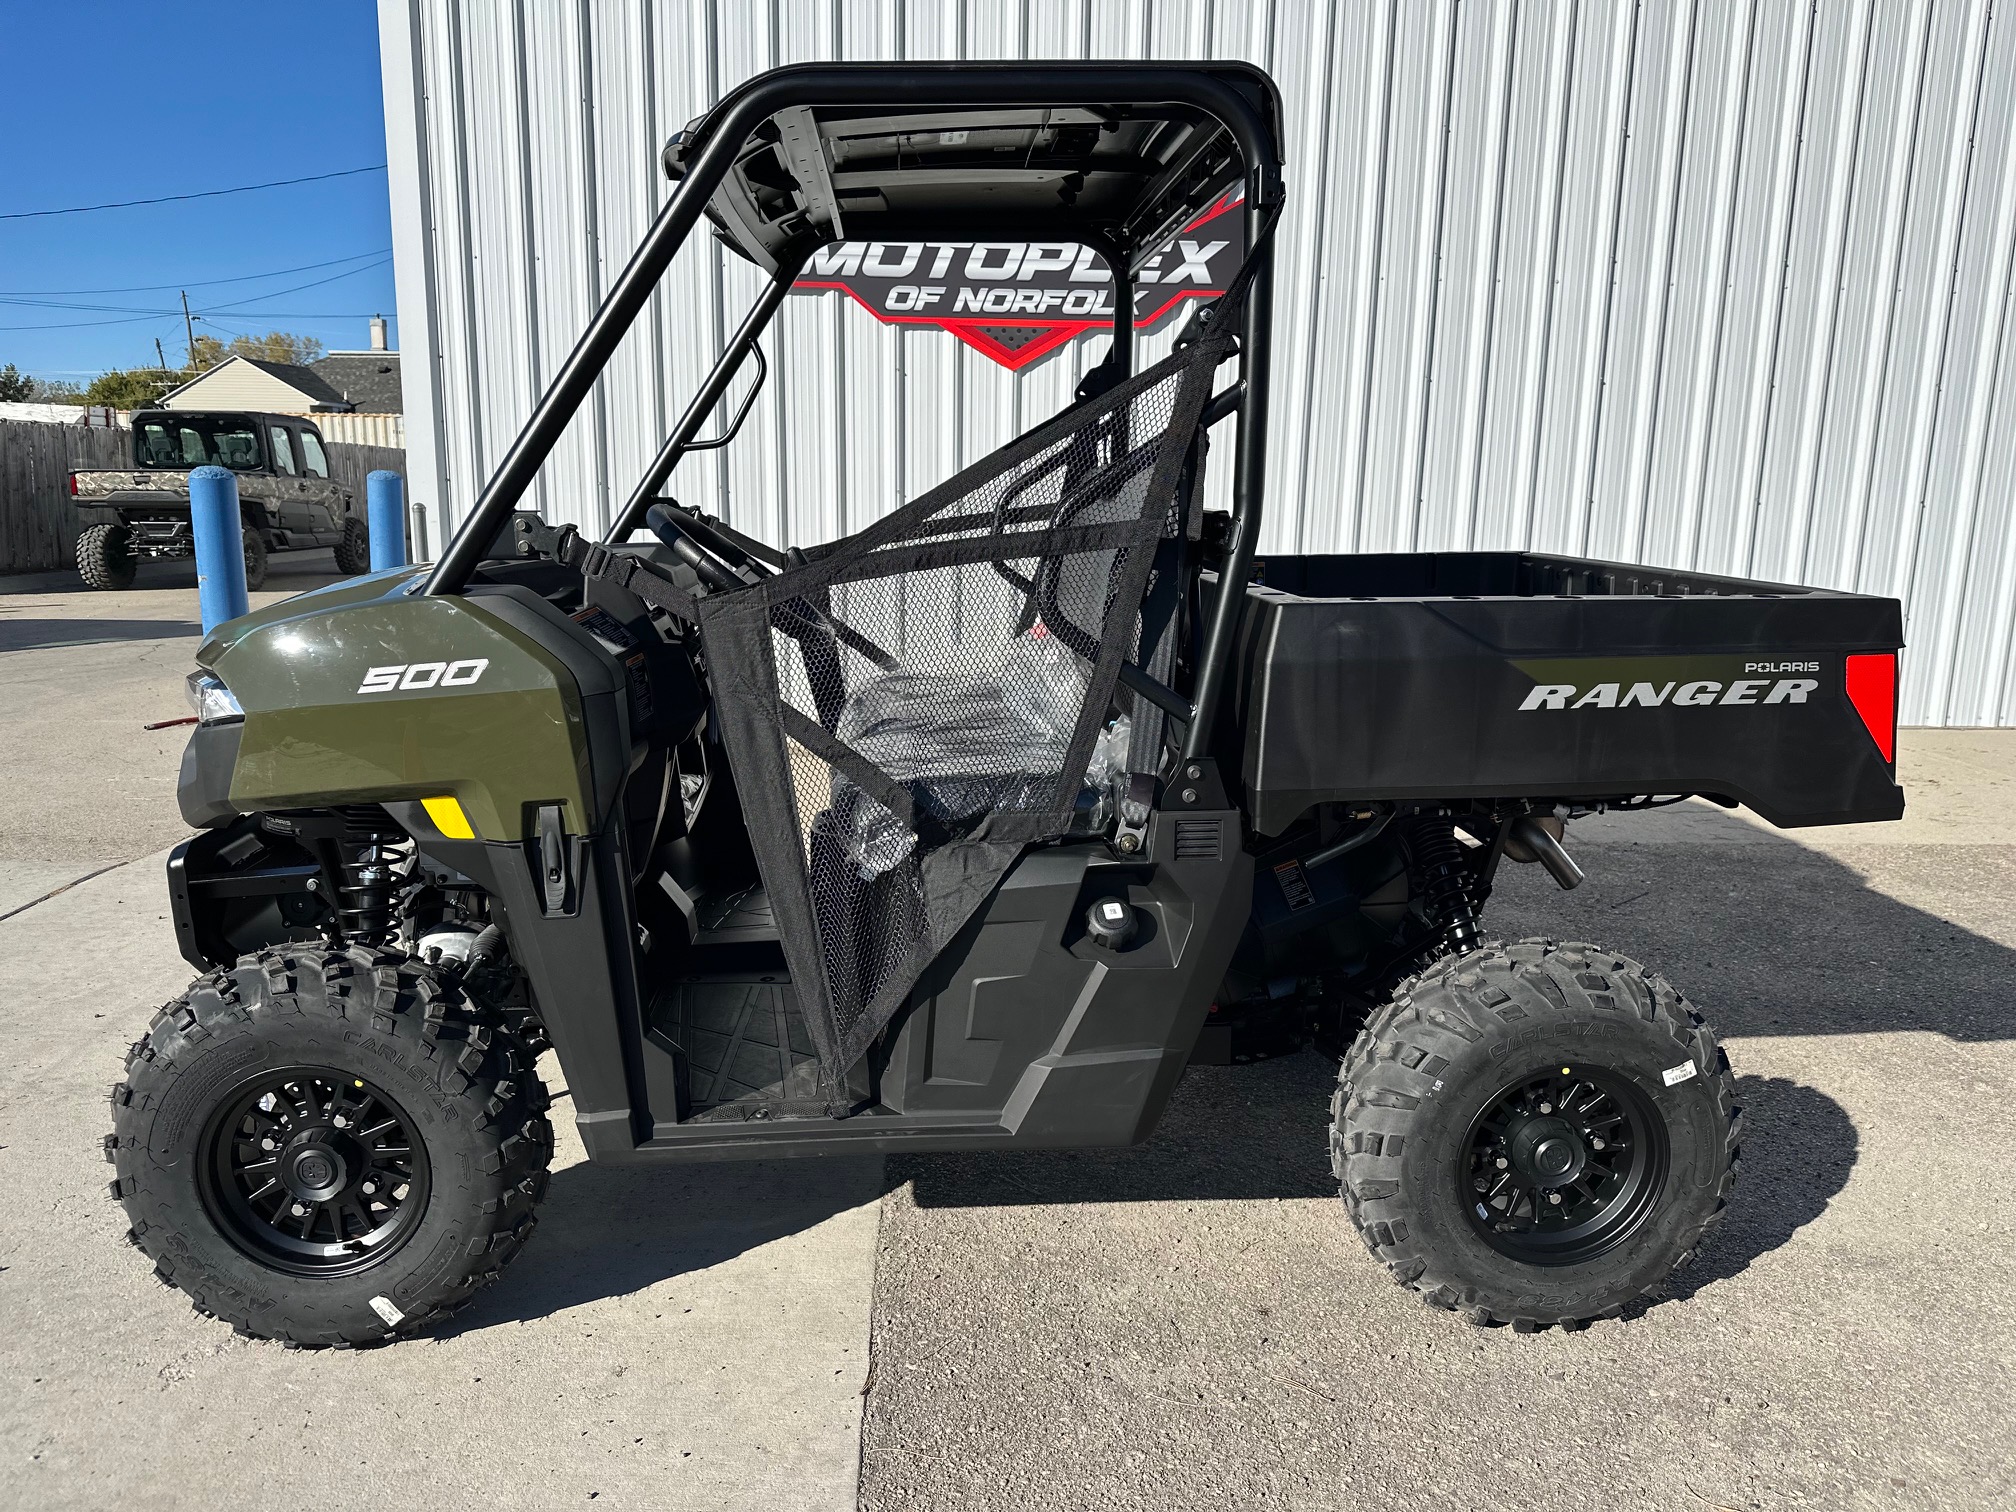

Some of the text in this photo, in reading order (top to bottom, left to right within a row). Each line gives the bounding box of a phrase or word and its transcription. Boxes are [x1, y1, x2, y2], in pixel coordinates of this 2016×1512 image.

[885, 285, 947, 311] OF
[357, 658, 489, 694] 500
[1745, 661, 1820, 673] POLARIS
[1518, 678, 1819, 711] RANGER
[1488, 1021, 1621, 1060] CARLSTAR
[343, 1029, 459, 1123] CARLSTAR
